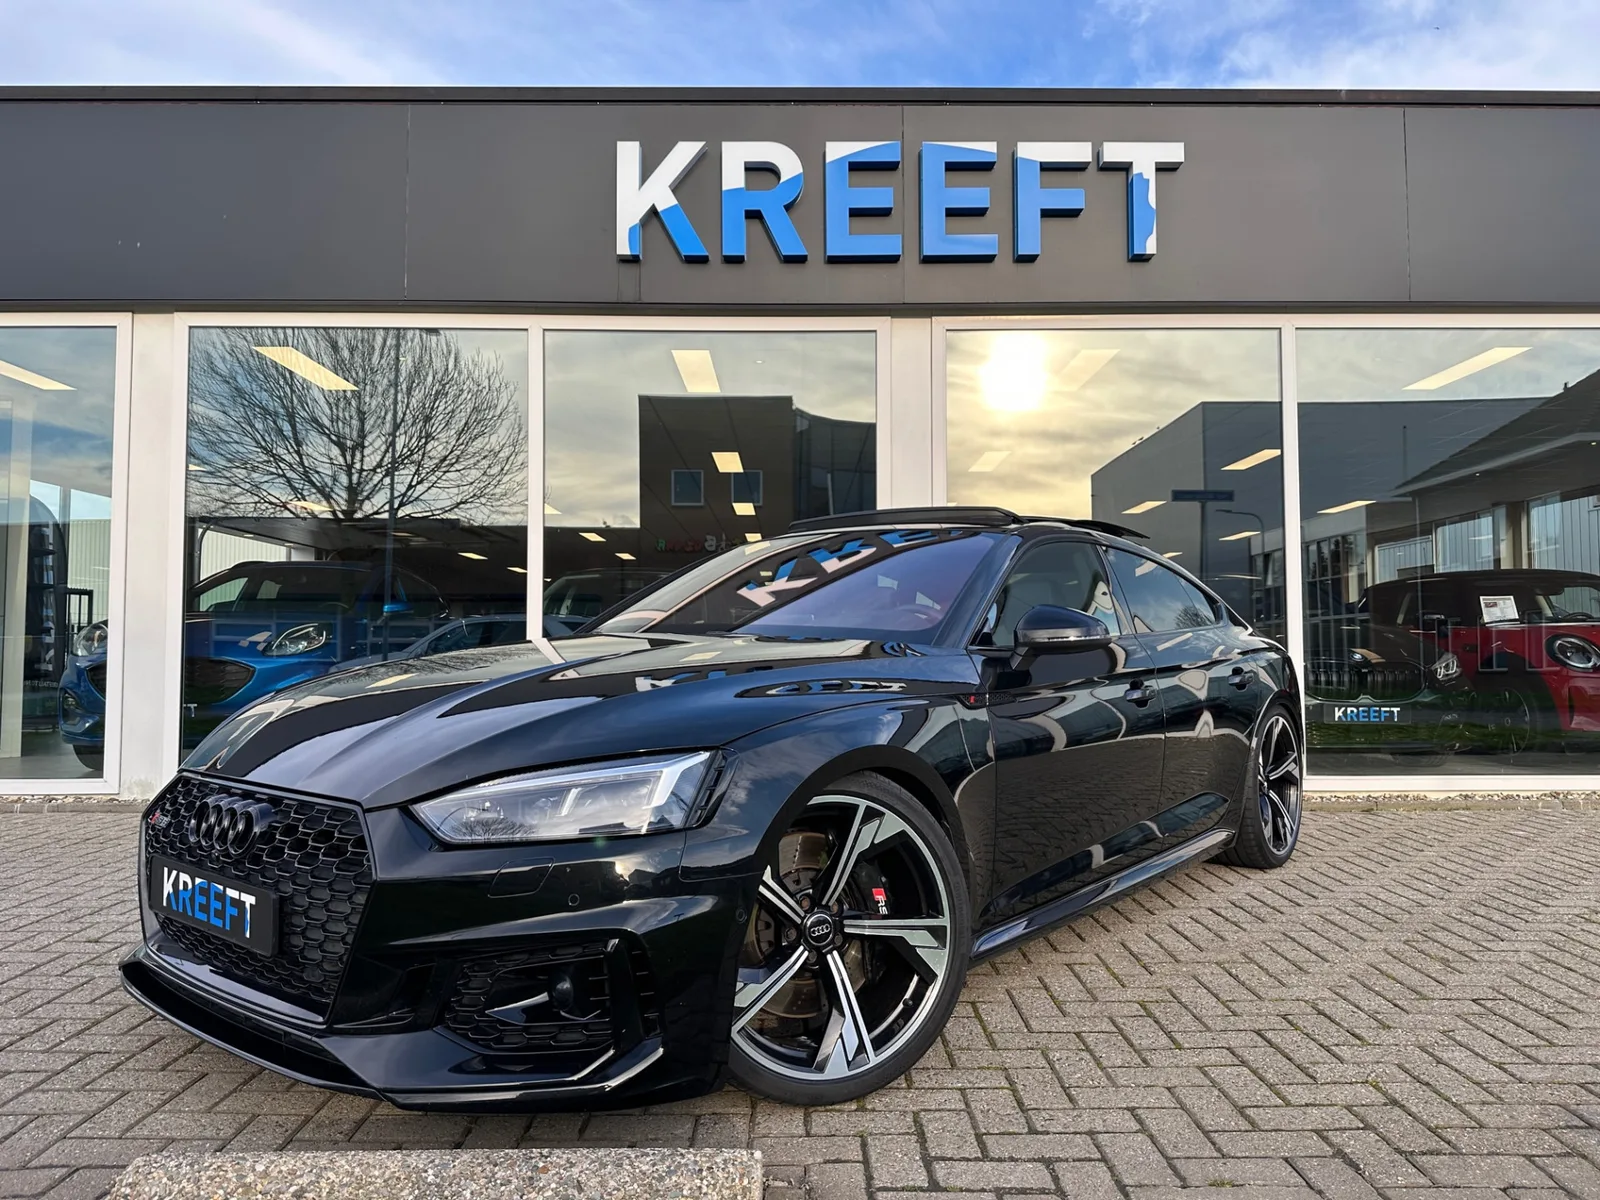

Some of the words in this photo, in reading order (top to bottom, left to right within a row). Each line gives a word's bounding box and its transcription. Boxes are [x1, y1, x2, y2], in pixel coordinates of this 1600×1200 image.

[616, 141, 1185, 261] KREEFT
[1334, 706, 1401, 722] KREEFT
[162, 866, 256, 939] KREEFT
